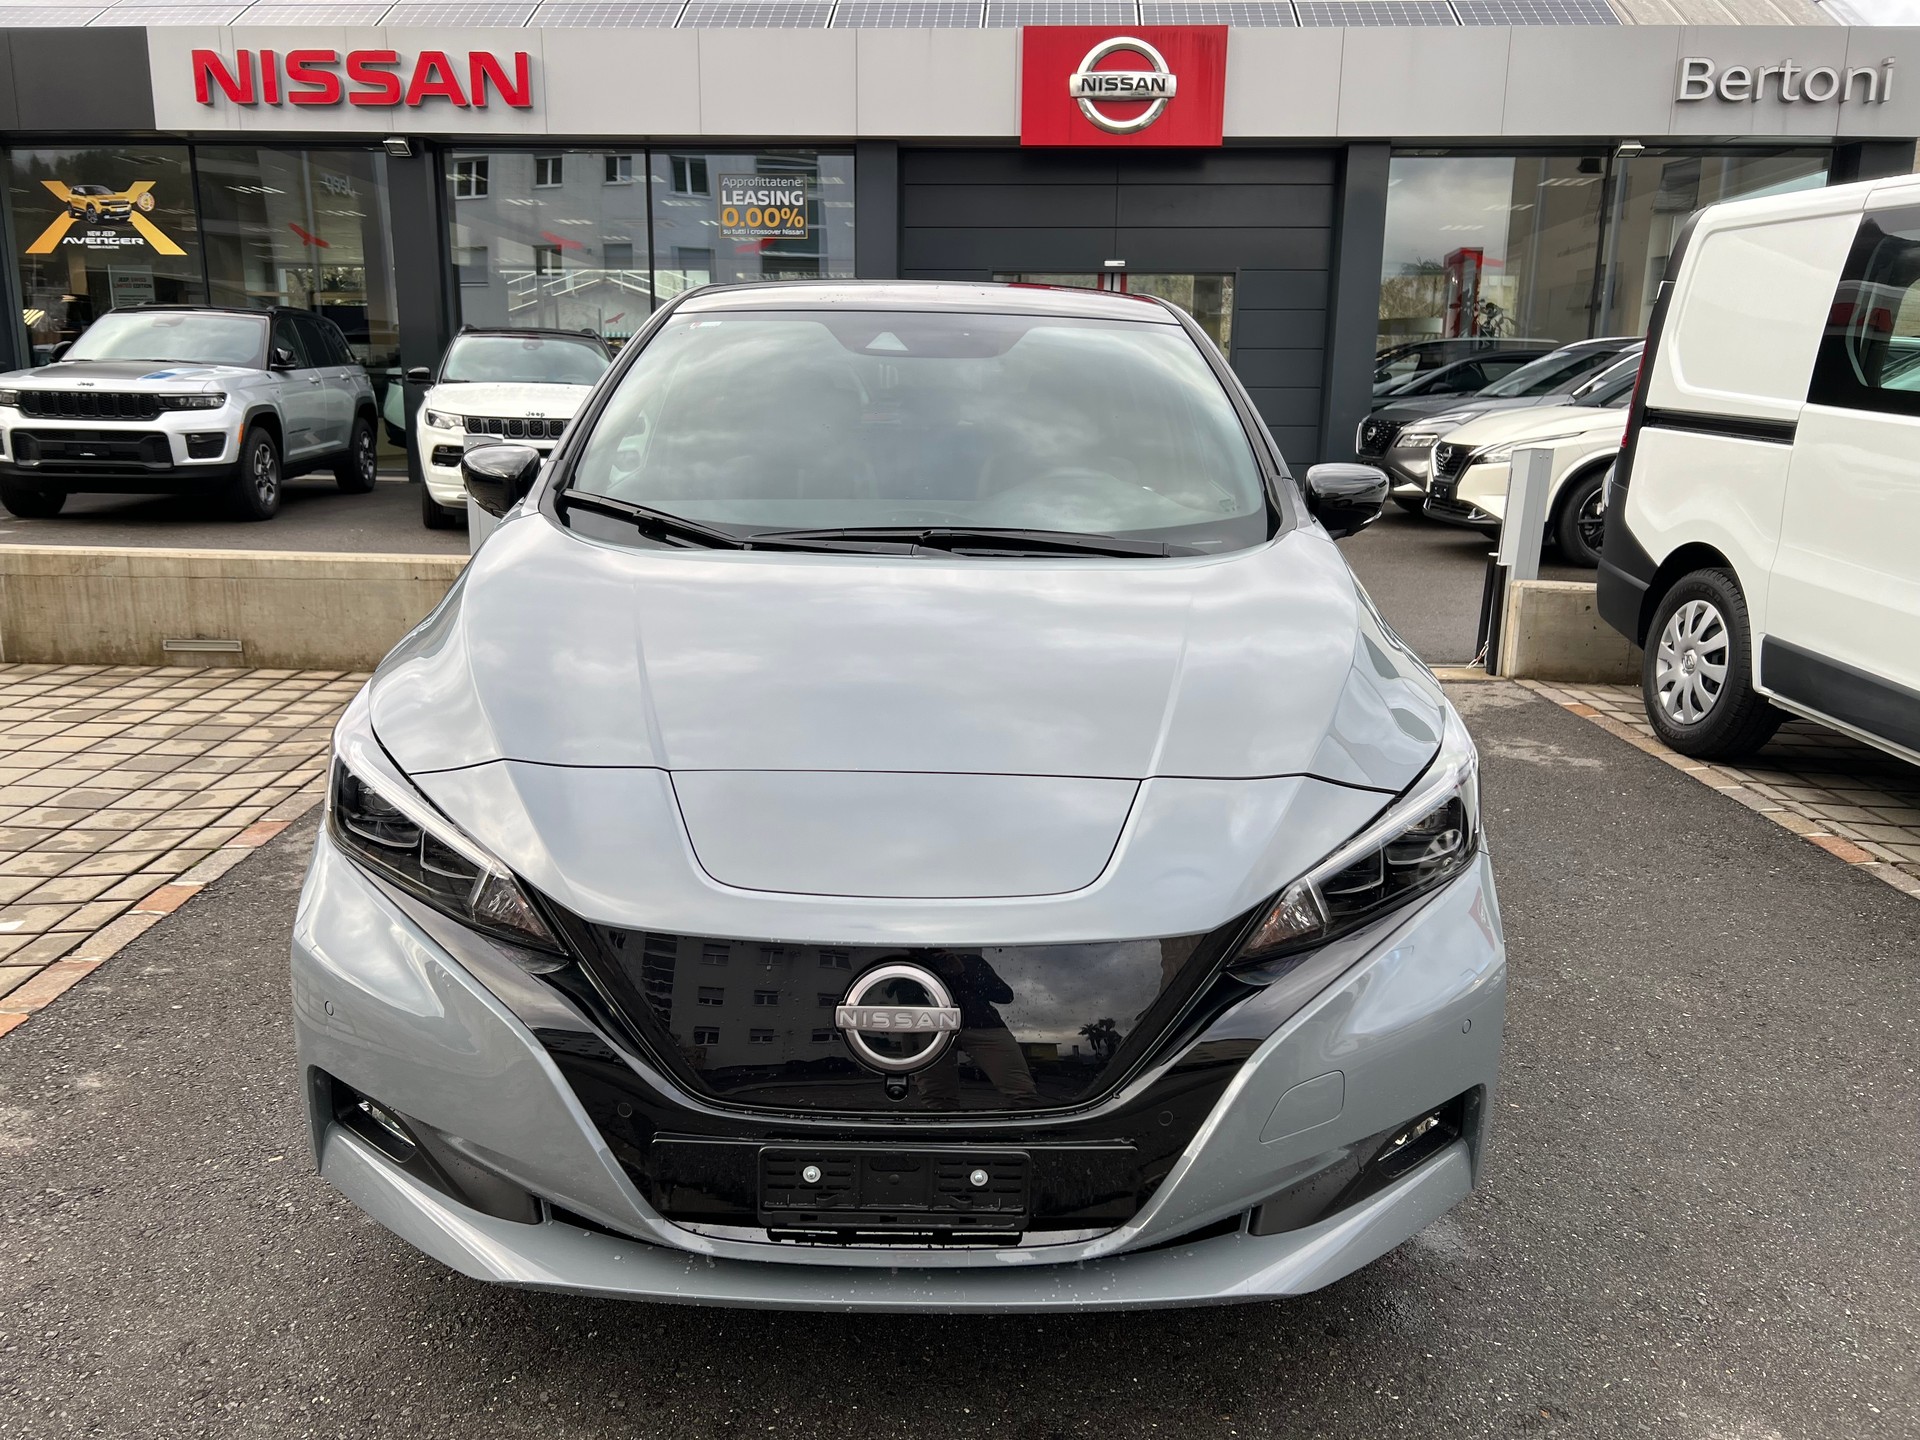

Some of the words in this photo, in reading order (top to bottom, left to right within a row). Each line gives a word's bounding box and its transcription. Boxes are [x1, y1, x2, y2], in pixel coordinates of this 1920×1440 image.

[191, 49, 533, 108] NISSAN
[1081, 77, 1166, 92] NISSAN
[1677, 56, 1897, 104] Bertoni
[722, 191, 804, 206] LEASING
[722, 207, 805, 228] 0.00%
[62, 237, 145, 245] AVENGER
[525, 410, 546, 418] Jeep
[839, 1009, 959, 1029] NISSAN
